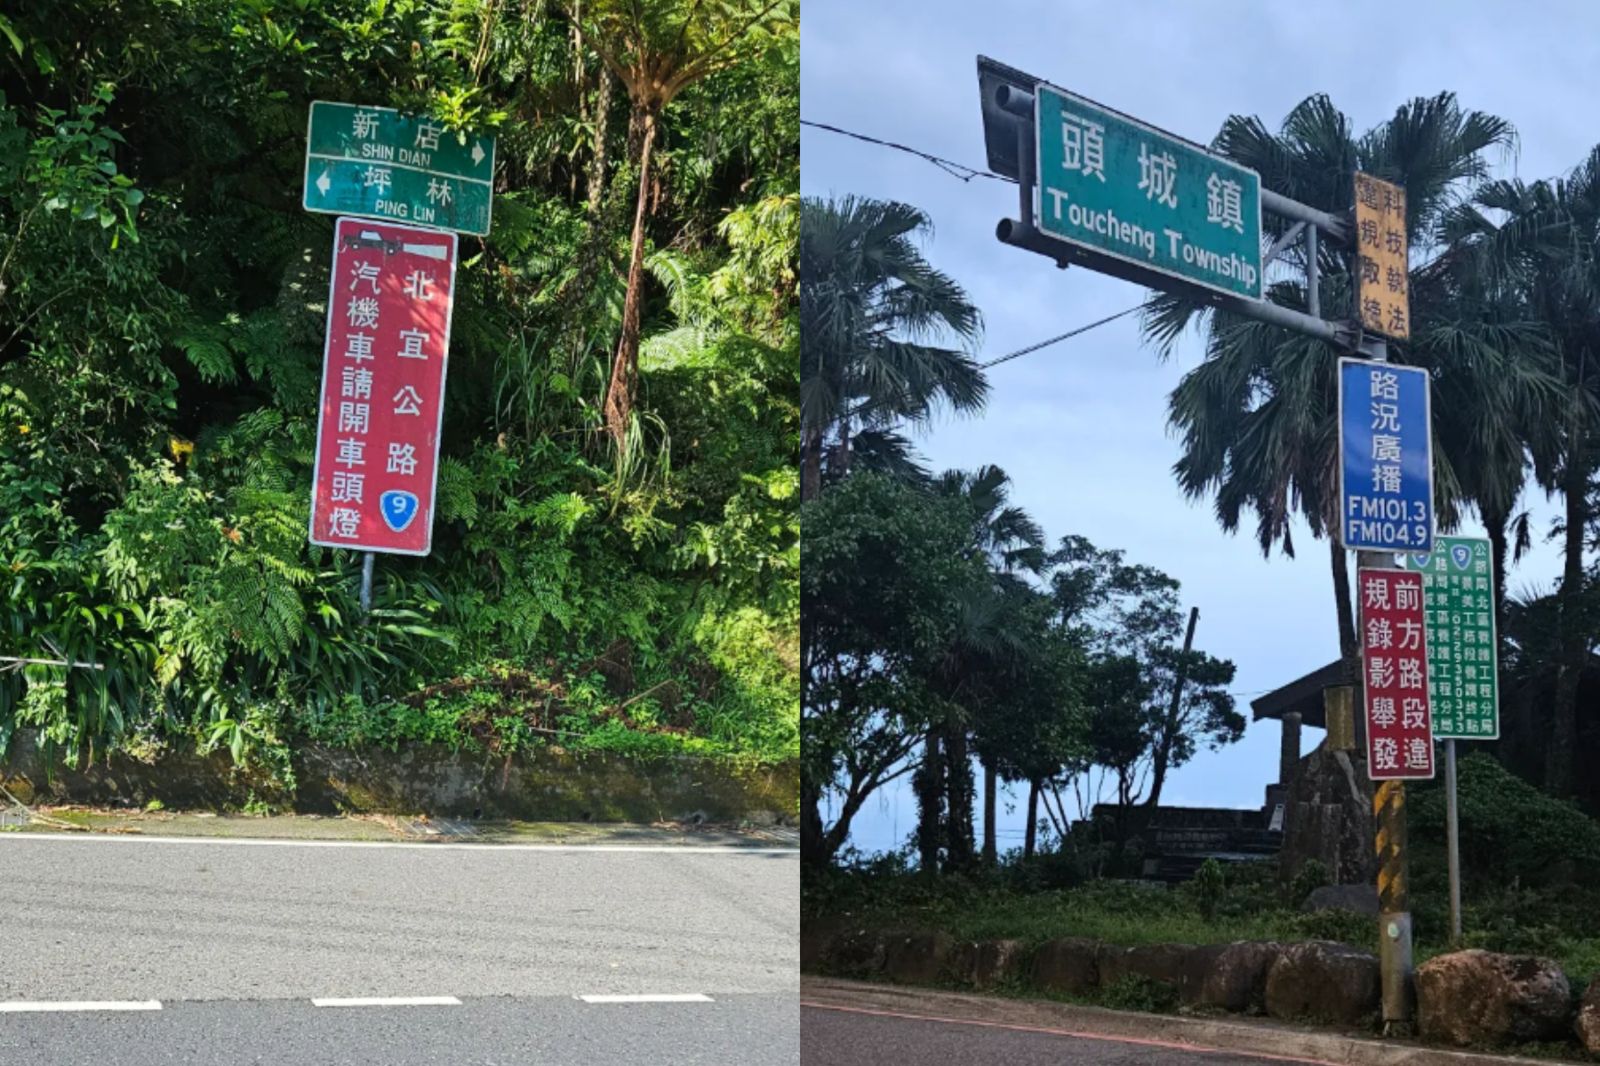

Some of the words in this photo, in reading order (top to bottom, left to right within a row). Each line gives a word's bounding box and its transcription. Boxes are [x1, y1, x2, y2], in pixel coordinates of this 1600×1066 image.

[352, 110, 442, 151] 新店
[362, 143, 394, 161] SHIN
[399, 148, 431, 167] DIAN
[1060, 110, 1244, 234] 頭城鎮
[363, 166, 452, 207] 坪林
[375, 199, 408, 217] PING
[413, 206, 435, 222] LIN
[1047, 186, 1155, 258] Toucheng
[1163, 228, 1257, 289] Township
[1383, 189, 1406, 333] 科技執法
[329, 260, 381, 539] 汽機車請開車頭燈
[386, 270, 435, 476] 北宜公路
[1370, 370, 1402, 493] 路況廣播
[392, 496, 407, 514] 9
[1348, 495, 1426, 522] FM101.3
[1349, 519, 1427, 546] FM104.9
[1365, 578, 1399, 770] 規錄影舉發
[1394, 579, 1430, 770] 前方路段違
